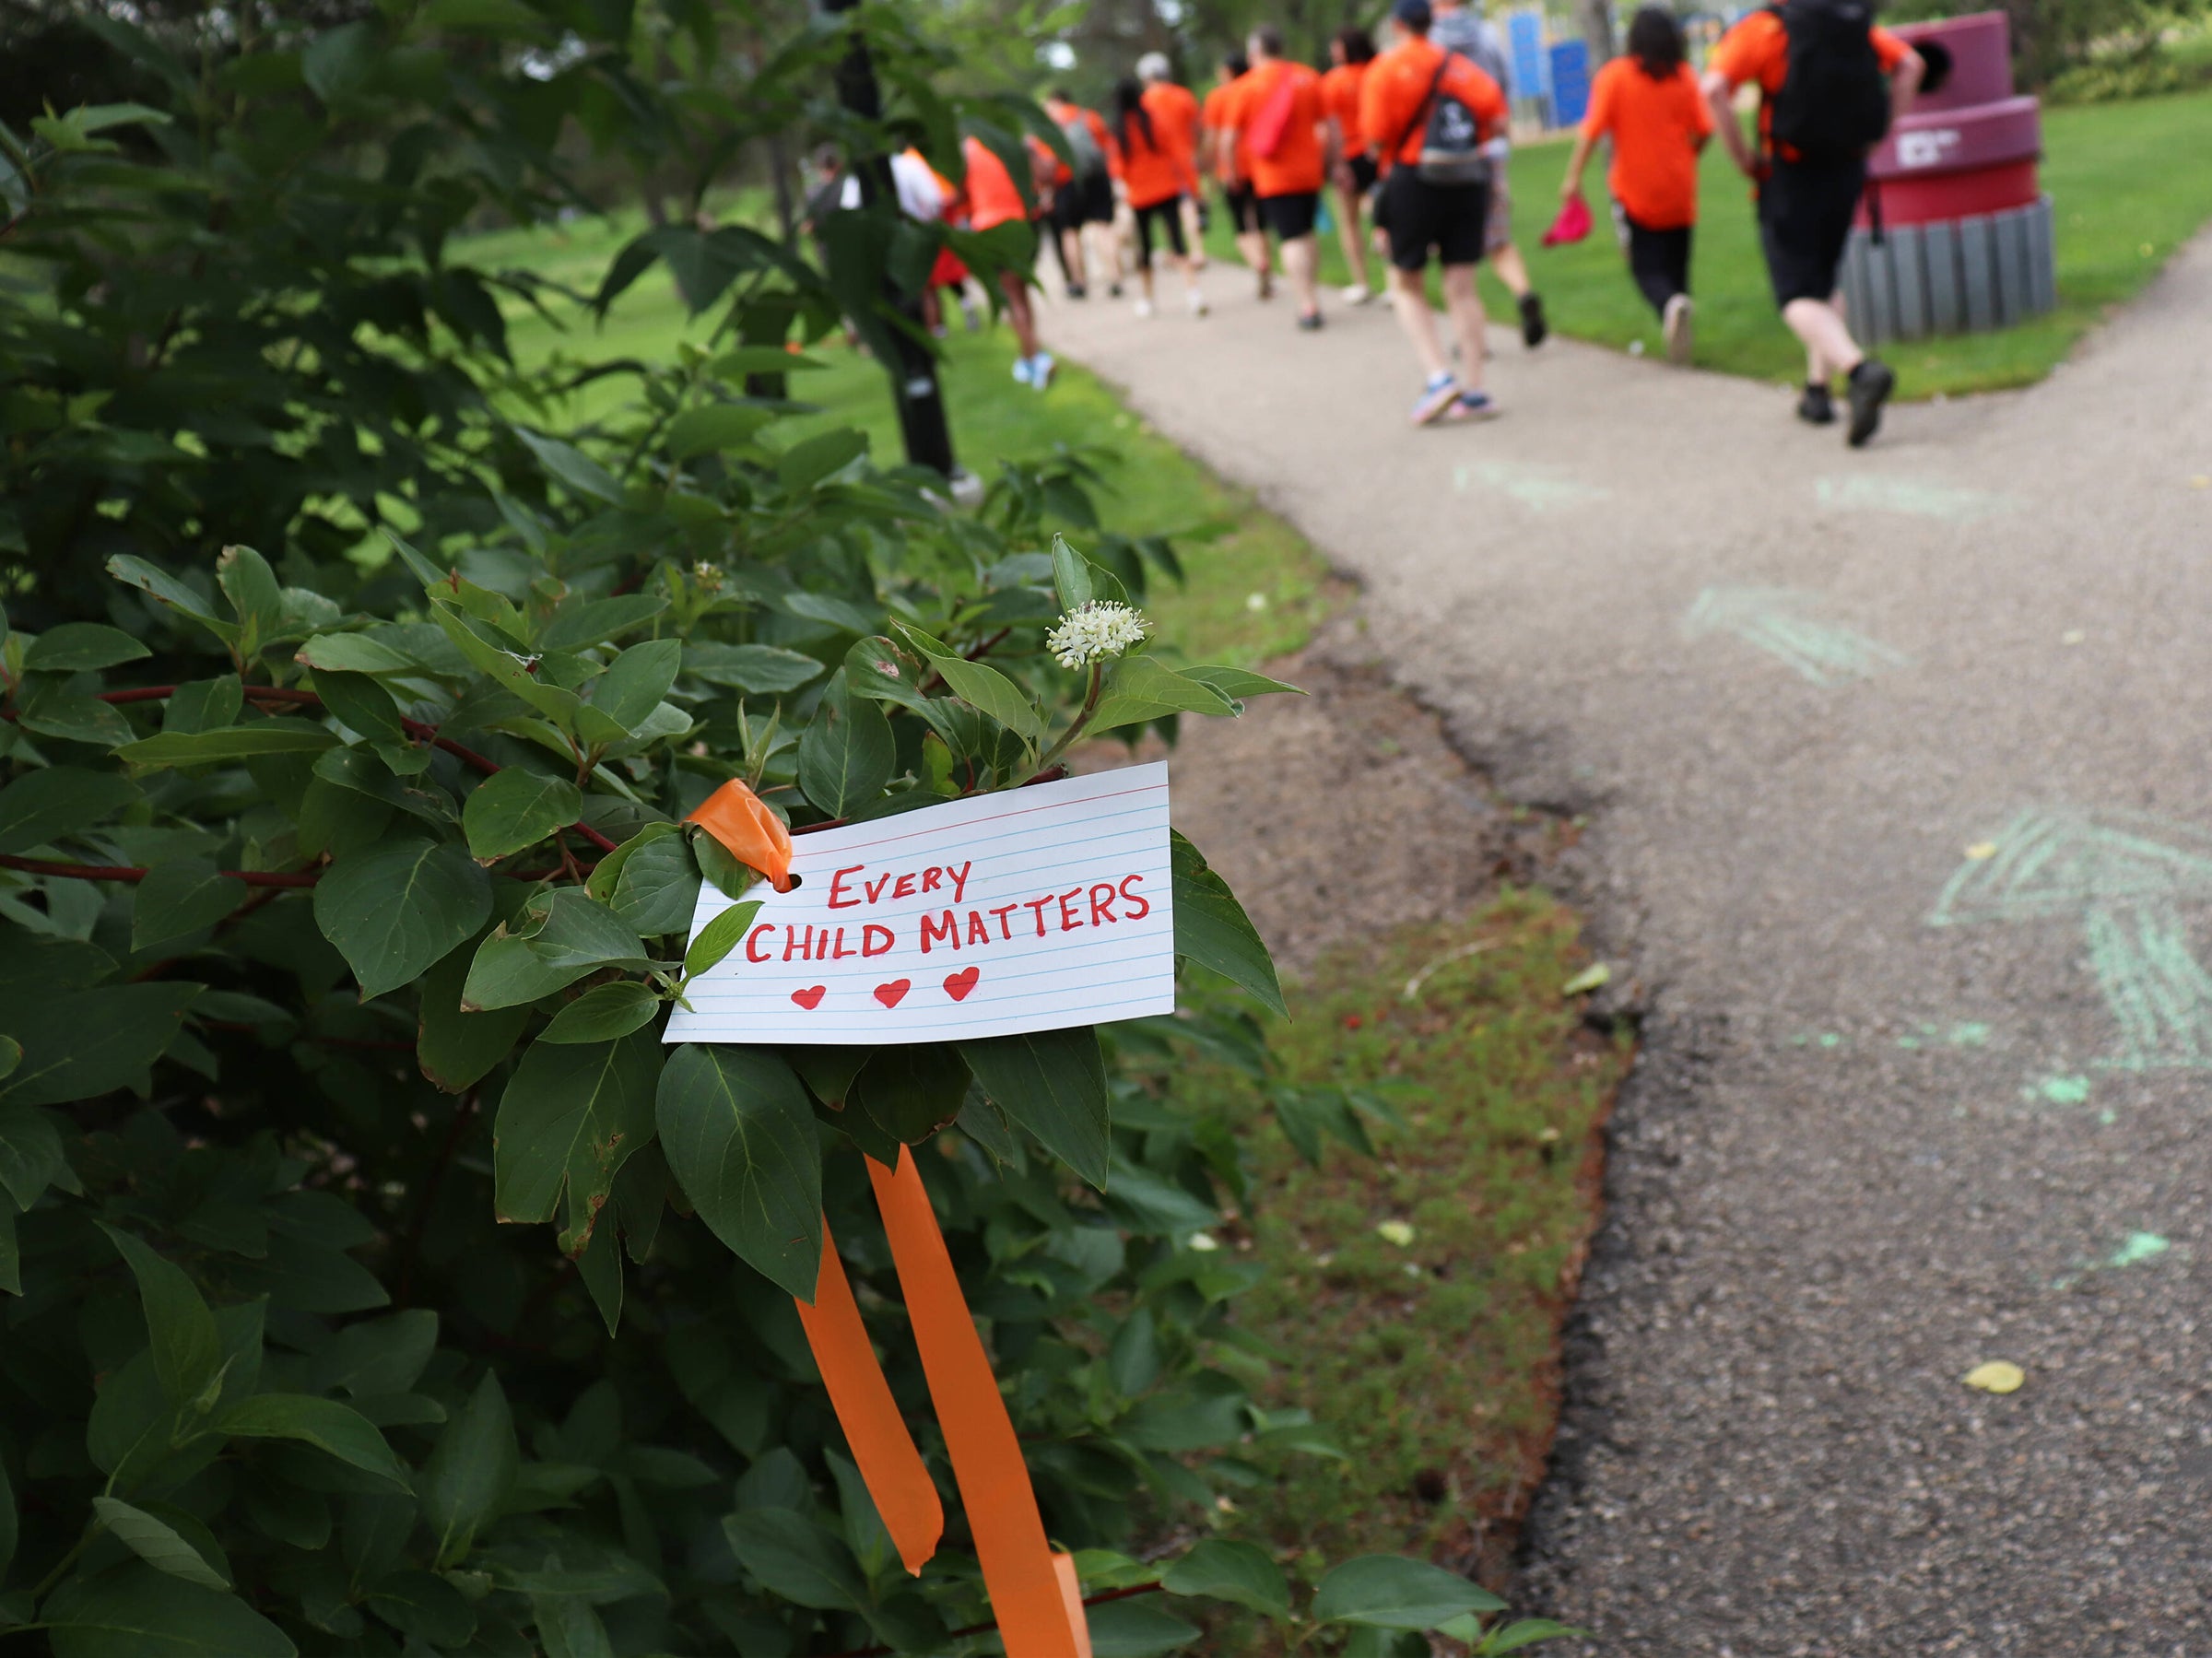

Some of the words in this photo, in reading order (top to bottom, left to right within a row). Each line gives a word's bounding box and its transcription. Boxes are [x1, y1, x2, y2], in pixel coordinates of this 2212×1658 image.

[746, 923, 896, 963] CHILD
[920, 874, 1150, 954] MATTERS
[828, 861, 971, 910] EVERY
